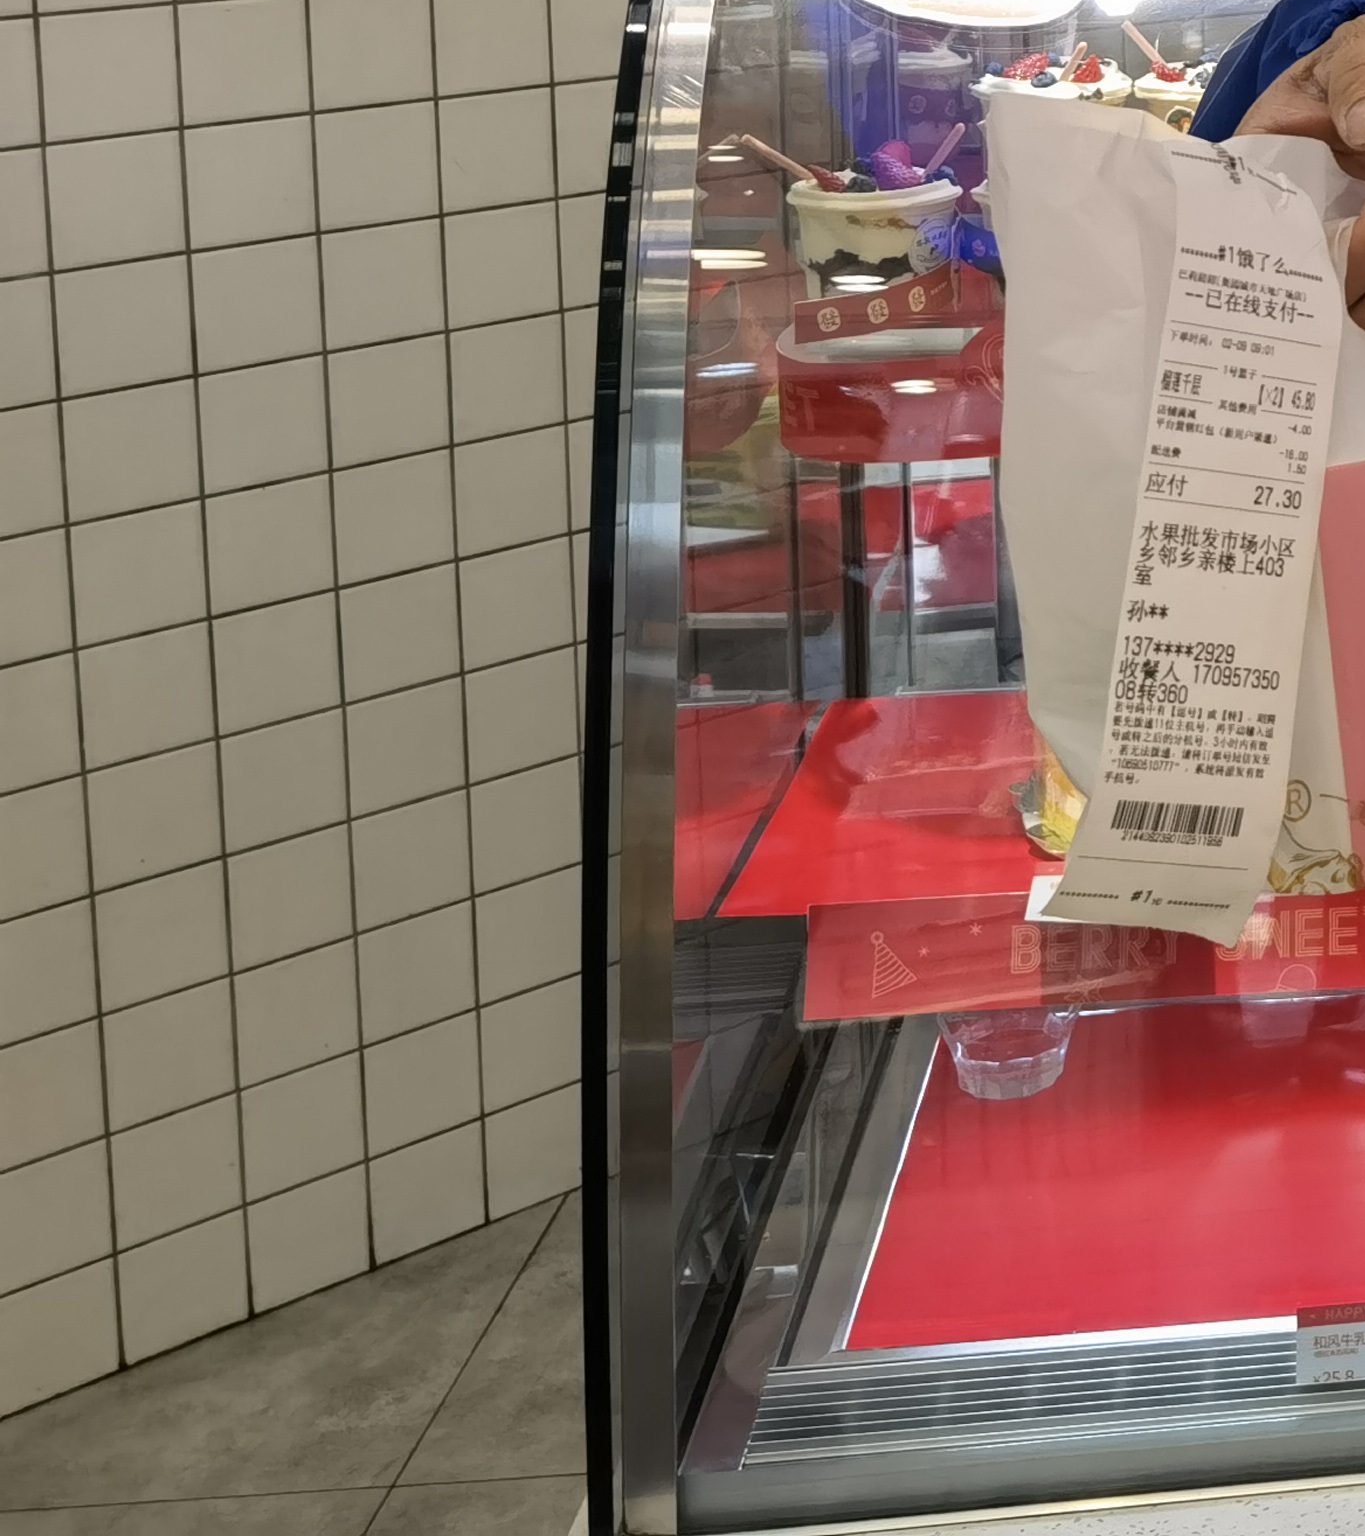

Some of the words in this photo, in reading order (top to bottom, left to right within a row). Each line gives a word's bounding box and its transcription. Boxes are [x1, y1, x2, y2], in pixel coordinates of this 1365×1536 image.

[1144, 470, 1189, 498] 应付
[1253, 485, 1302, 510] 27.30
[1136, 538, 1285, 577] 乡邻乡亲楼上403
[1139, 520, 1296, 558] 水果批发市场小区
[1132, 564, 1155, 586] 室
[1115, 678, 1189, 705] 08转360
[1118, 657, 1180, 683] 收餐人
[1193, 664, 1281, 691] 170957350
[1010, 924, 1181, 975] BERRY
